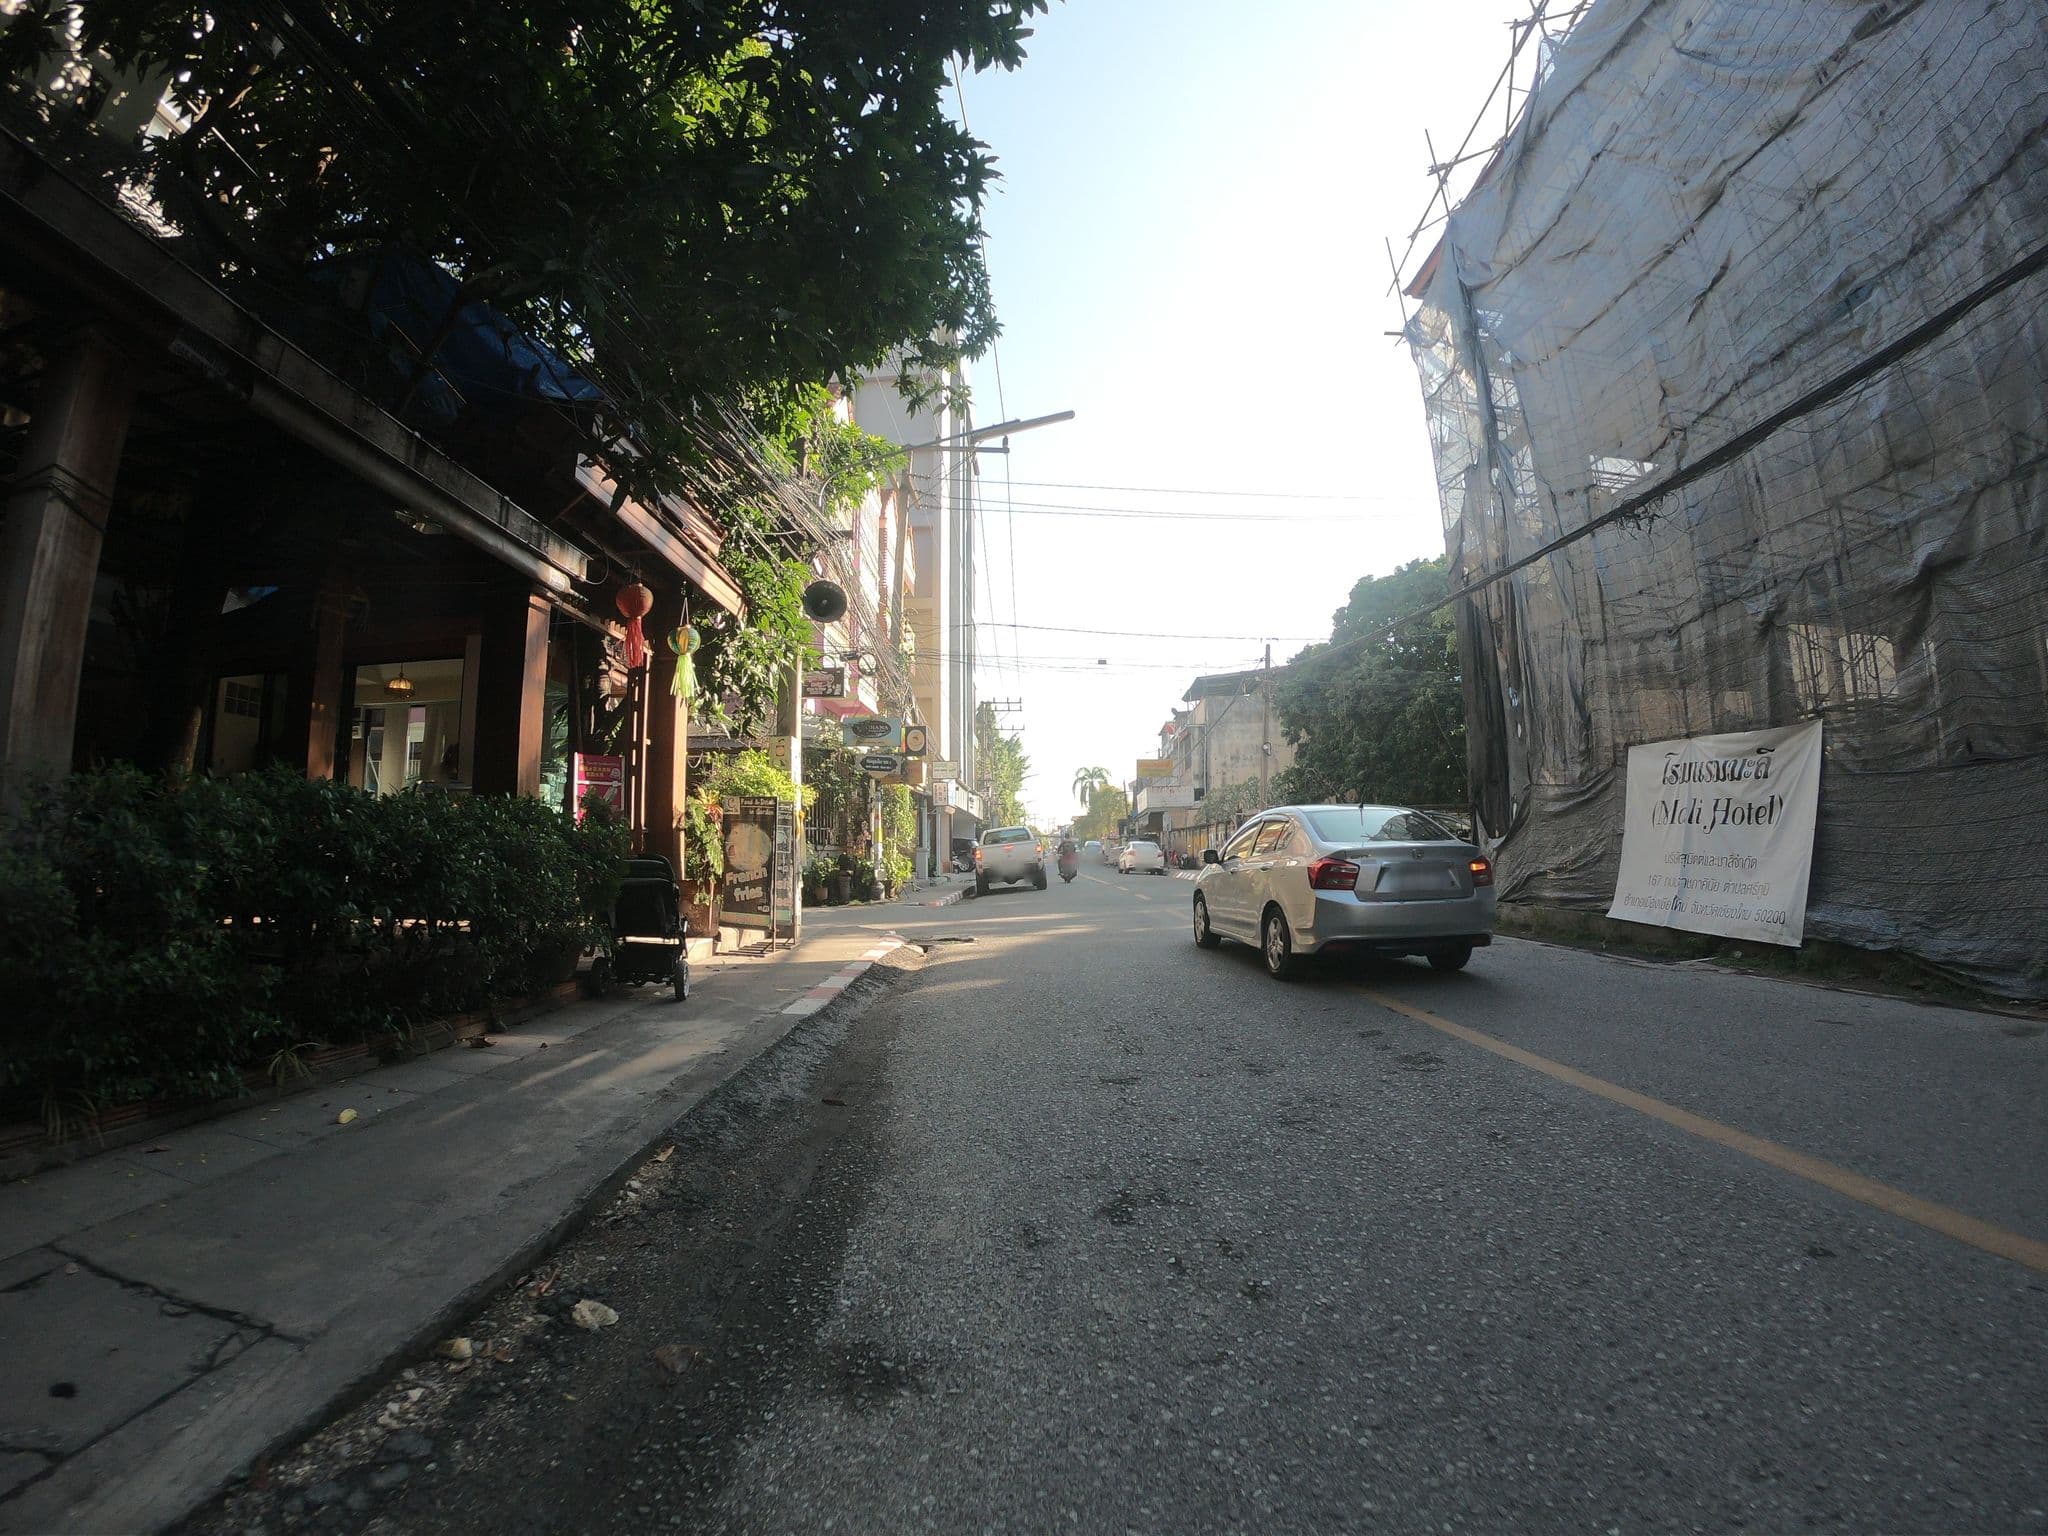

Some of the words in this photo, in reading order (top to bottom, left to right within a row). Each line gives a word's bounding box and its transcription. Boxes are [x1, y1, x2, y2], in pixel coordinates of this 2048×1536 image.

[1703, 794, 1784, 834] Hotel)
[725, 866, 768, 887] French
[1754, 908, 1786, 924] 50200
